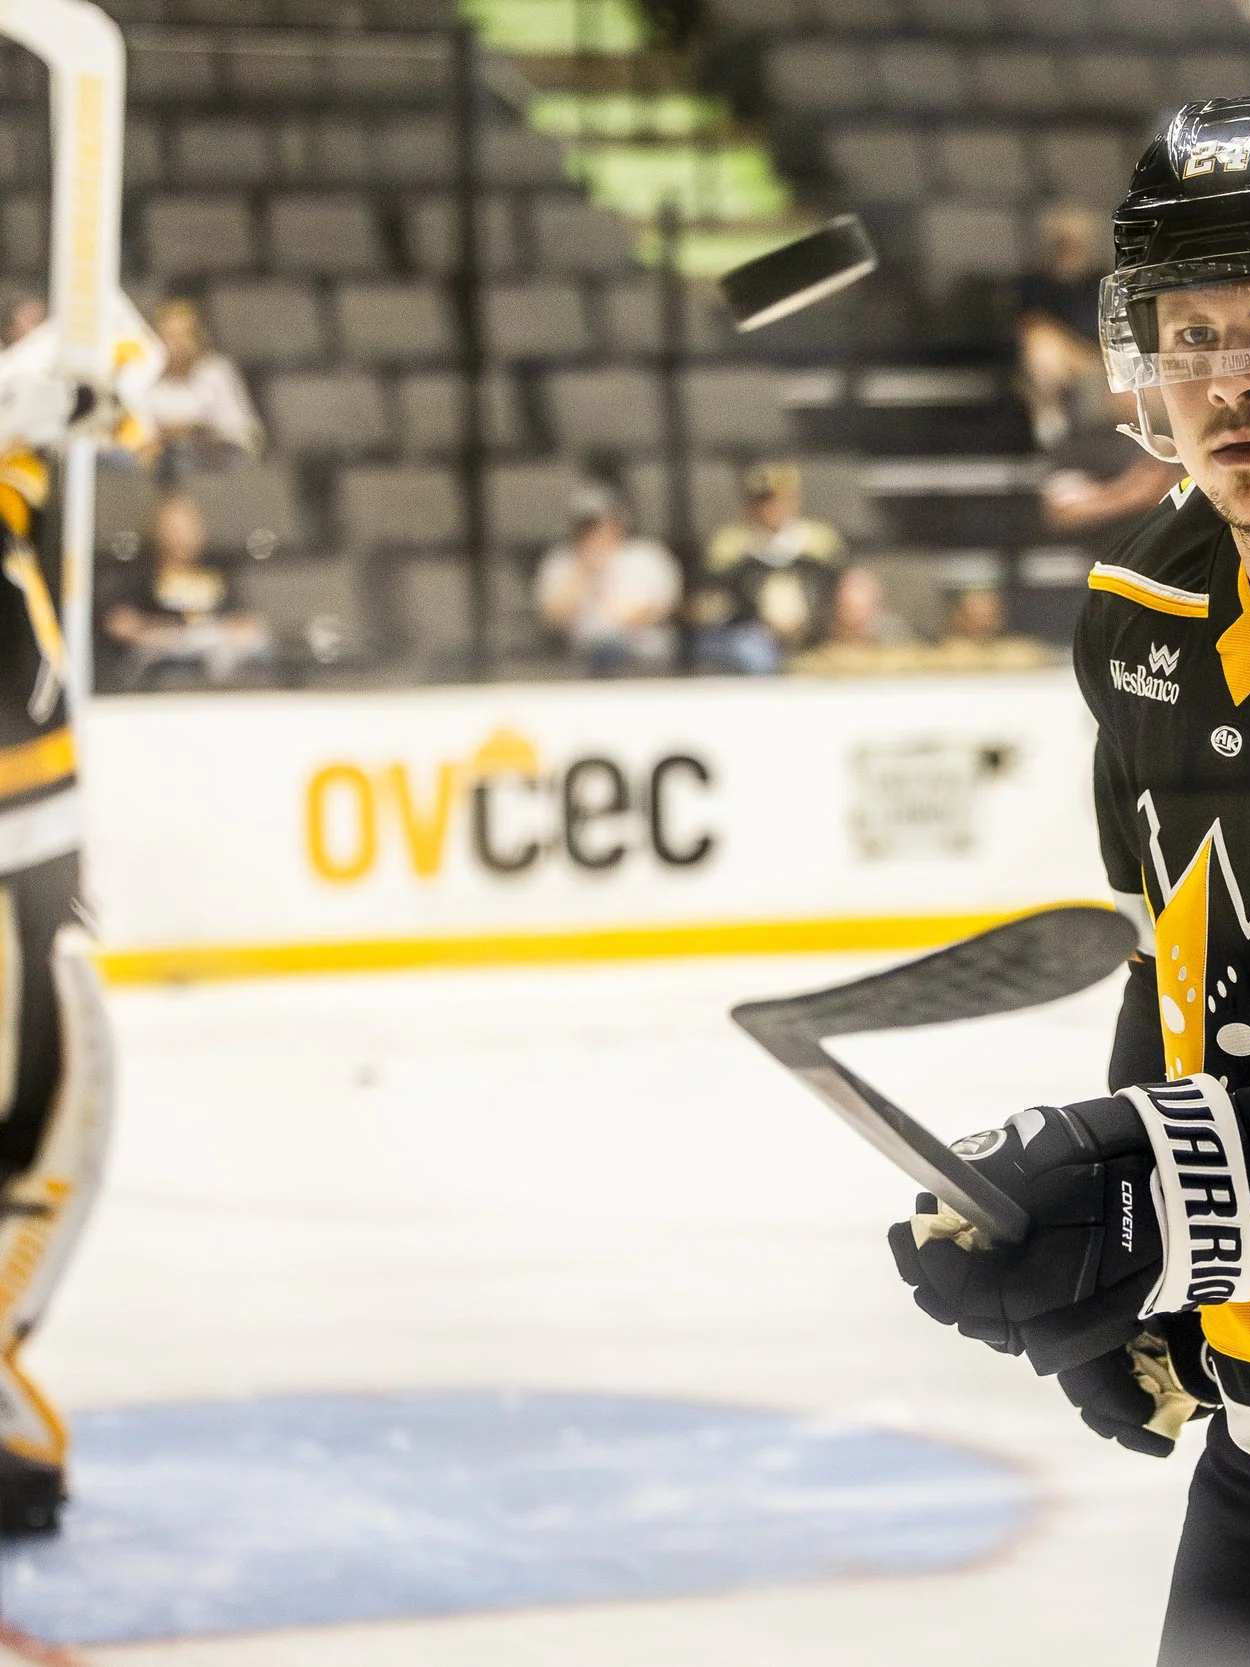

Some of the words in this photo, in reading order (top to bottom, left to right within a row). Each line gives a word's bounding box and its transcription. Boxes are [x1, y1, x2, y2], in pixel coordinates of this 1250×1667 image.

[1182, 137, 1250, 179] 24
[1110, 659, 1180, 705] WesBanco
[1120, 1180, 1133, 1252] COVERT
[1141, 1078, 1243, 1307] WARRIO
